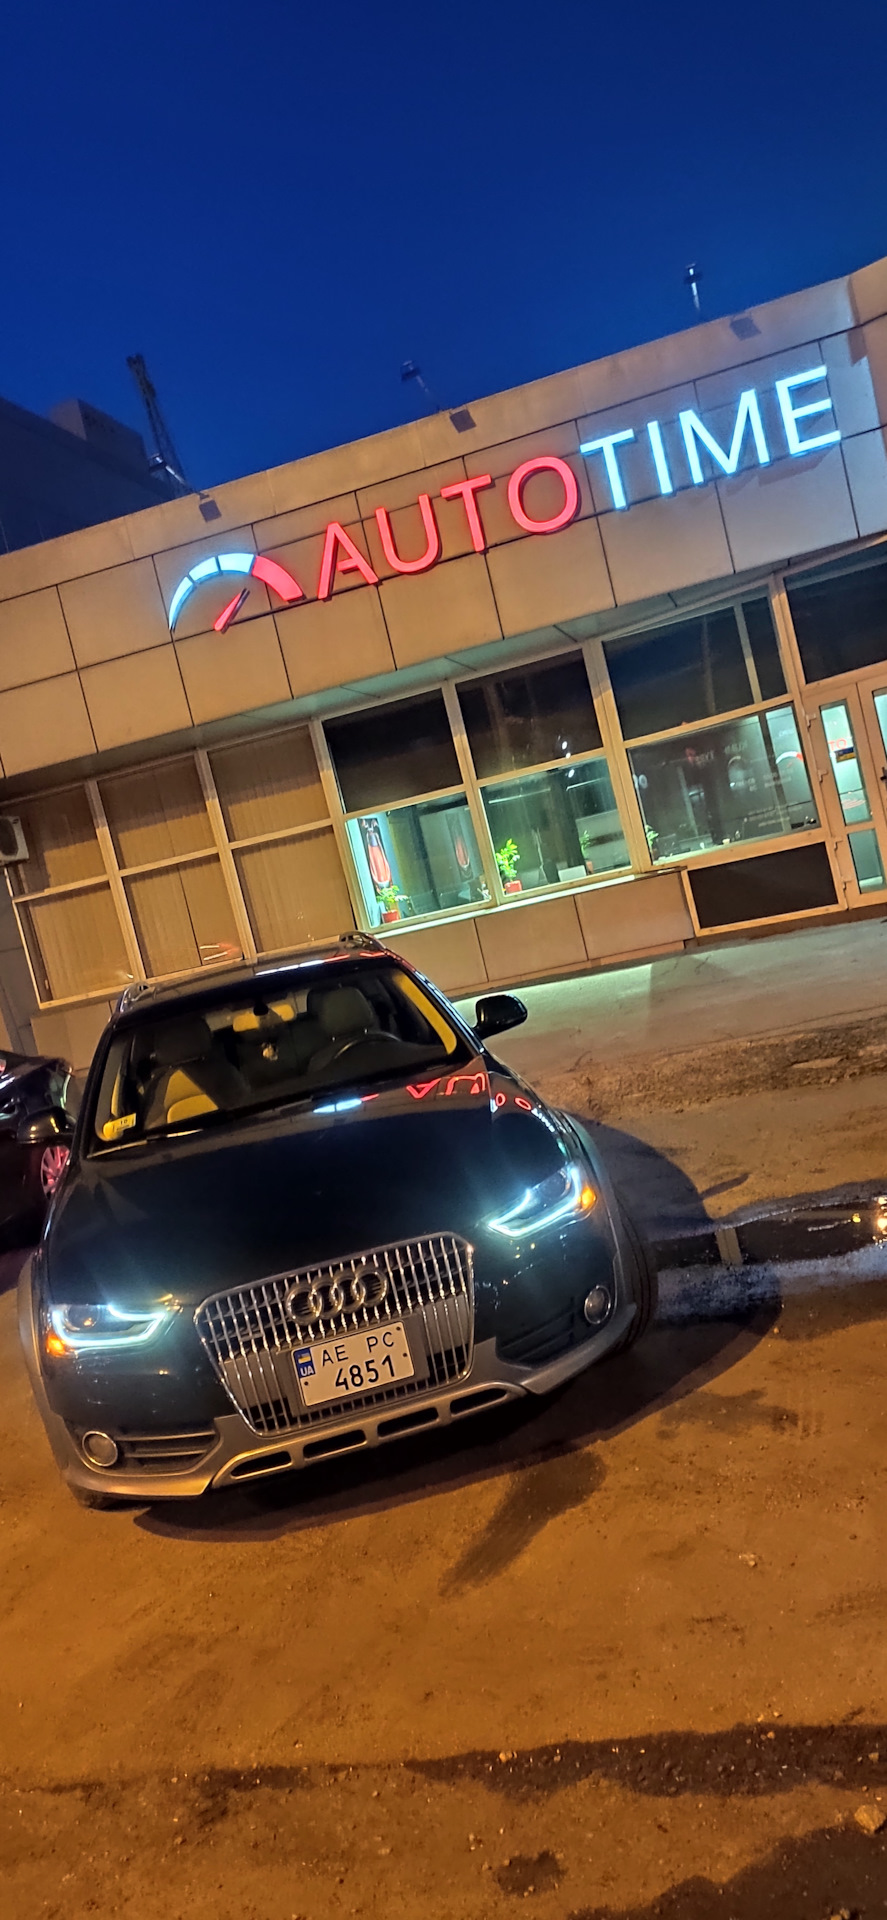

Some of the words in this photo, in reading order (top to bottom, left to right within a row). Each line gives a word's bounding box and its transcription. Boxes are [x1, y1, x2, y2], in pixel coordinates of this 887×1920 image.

[321, 1344, 349, 1367] AE
[366, 1331, 395, 1353] PC
[300, 1365, 315, 1377] UA
[335, 1354, 395, 1391] 4851
